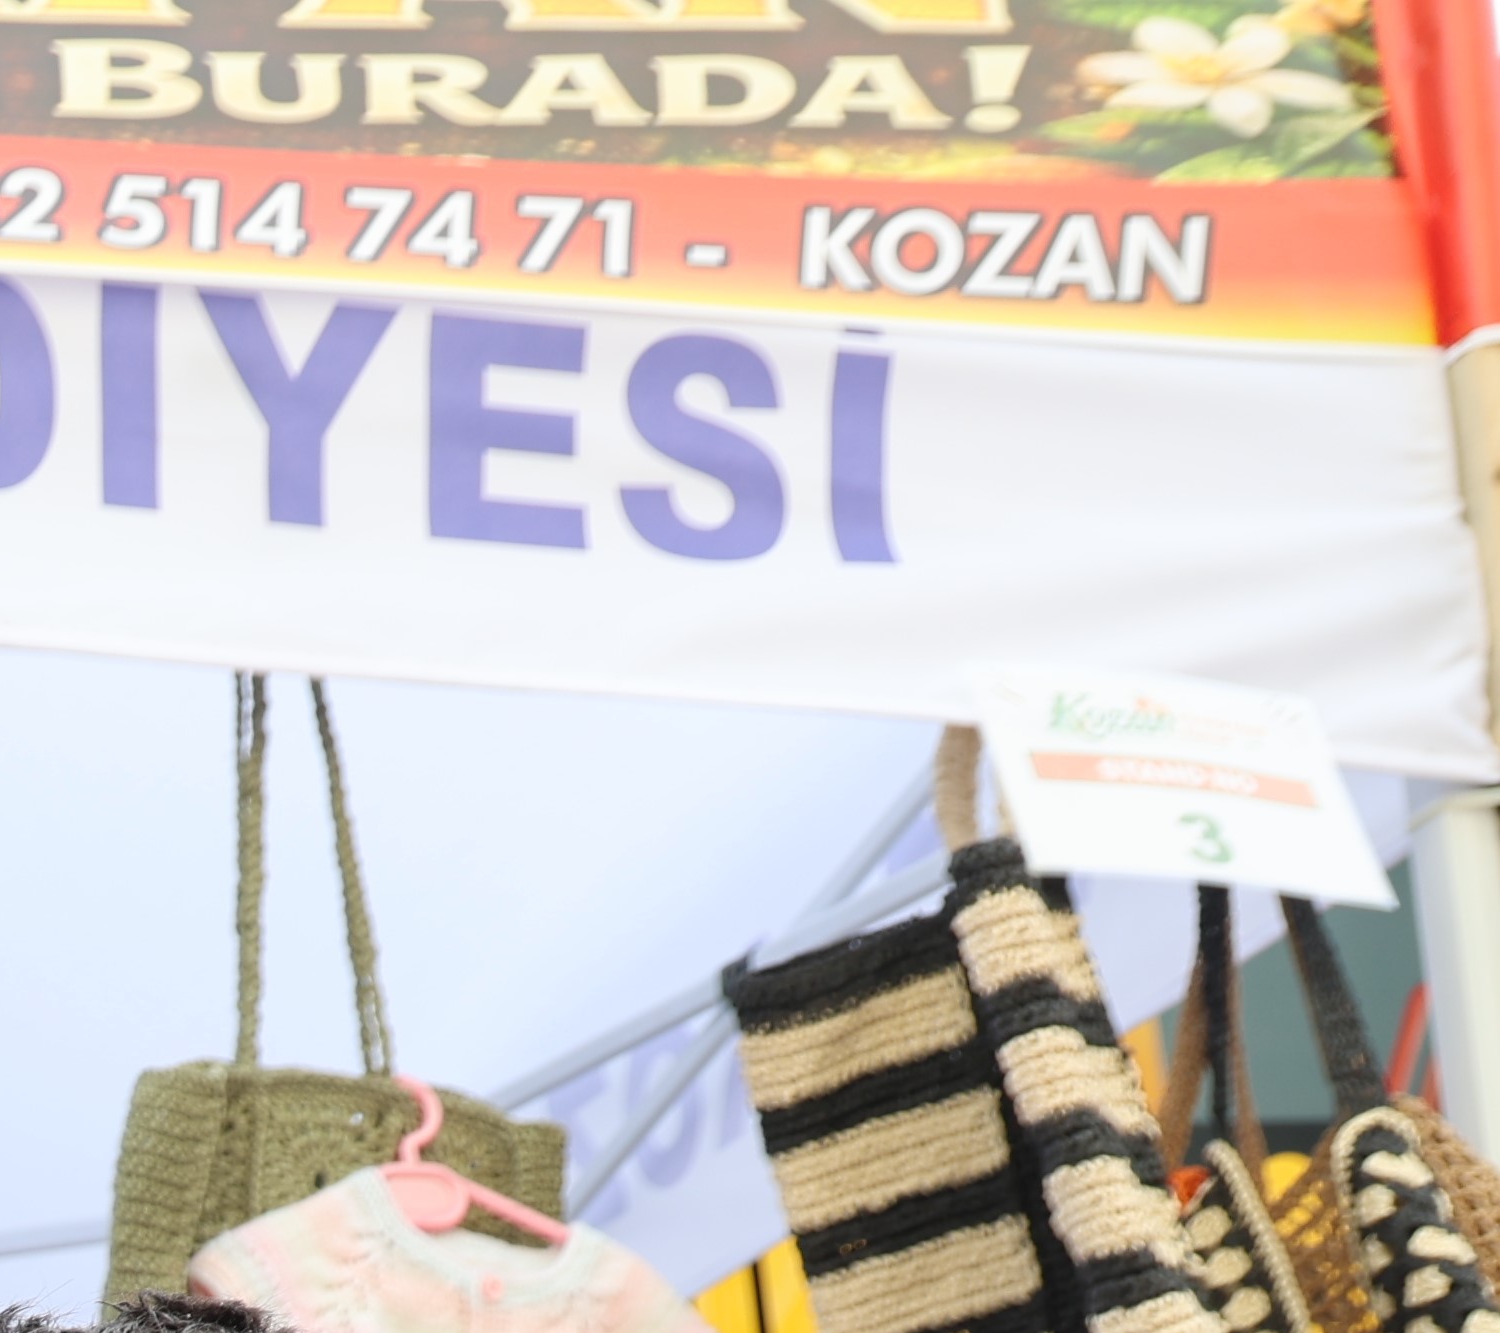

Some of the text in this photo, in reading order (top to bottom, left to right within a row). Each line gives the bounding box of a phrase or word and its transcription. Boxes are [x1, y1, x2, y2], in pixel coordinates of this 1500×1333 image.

[50, 36, 1033, 135] BURADA!
[100, 176, 308, 260] 514
[343, 188, 481, 271] 74
[515, 196, 636, 280] 71
[797, 205, 1212, 305] KOZAN
[1178, 812, 1236, 864] 3
